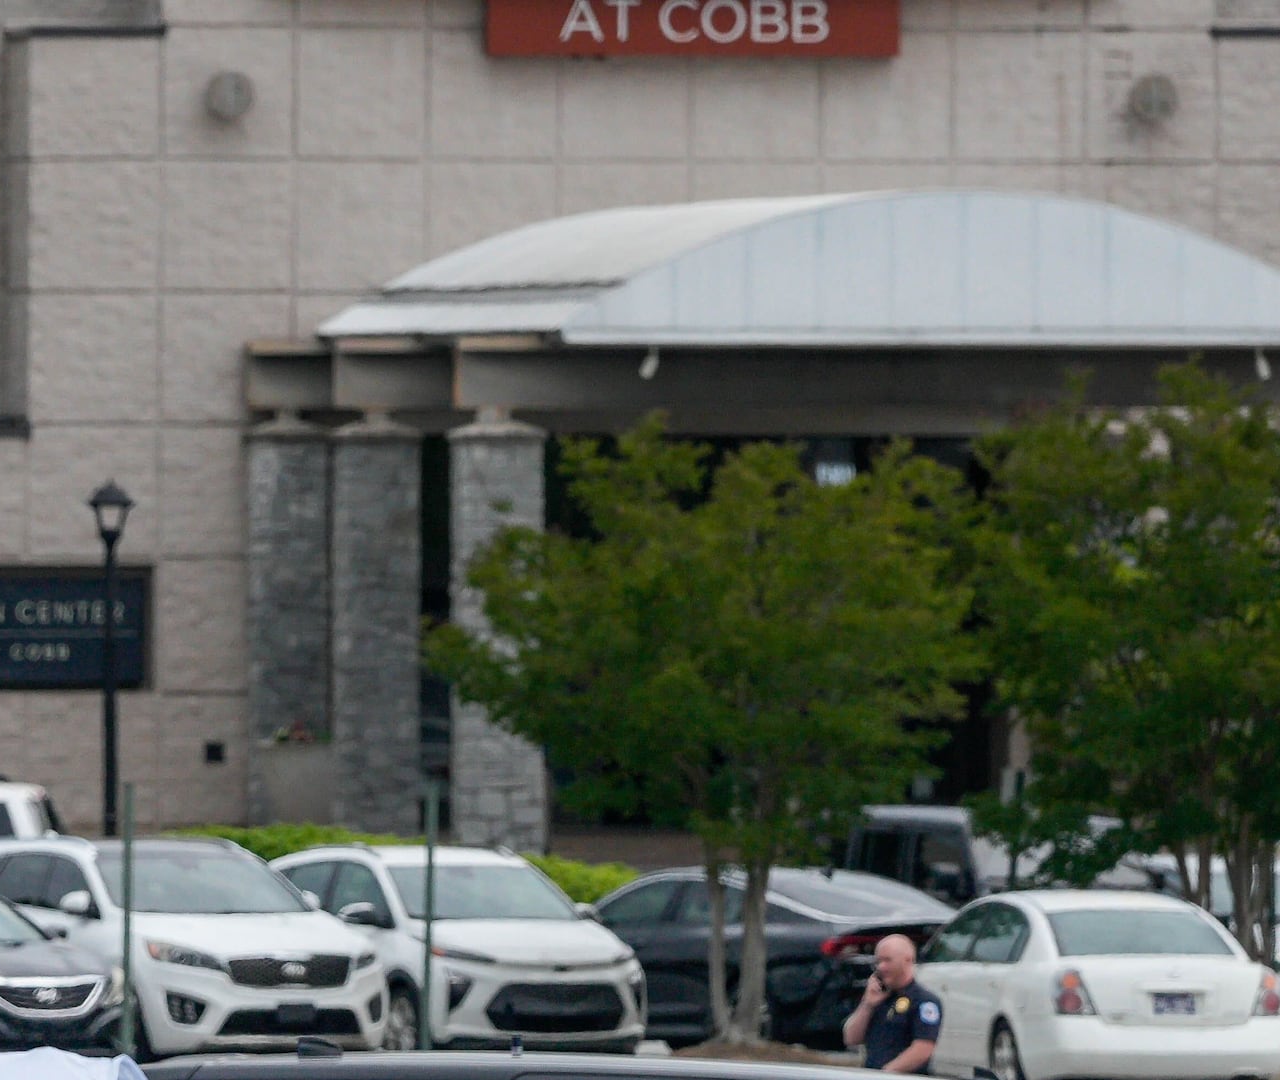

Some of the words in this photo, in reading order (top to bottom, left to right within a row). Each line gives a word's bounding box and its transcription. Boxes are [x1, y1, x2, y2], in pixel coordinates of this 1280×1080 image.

[558, 0, 639, 42] AT
[658, 0, 832, 43] COBB
[14, 599, 126, 625] CENTER
